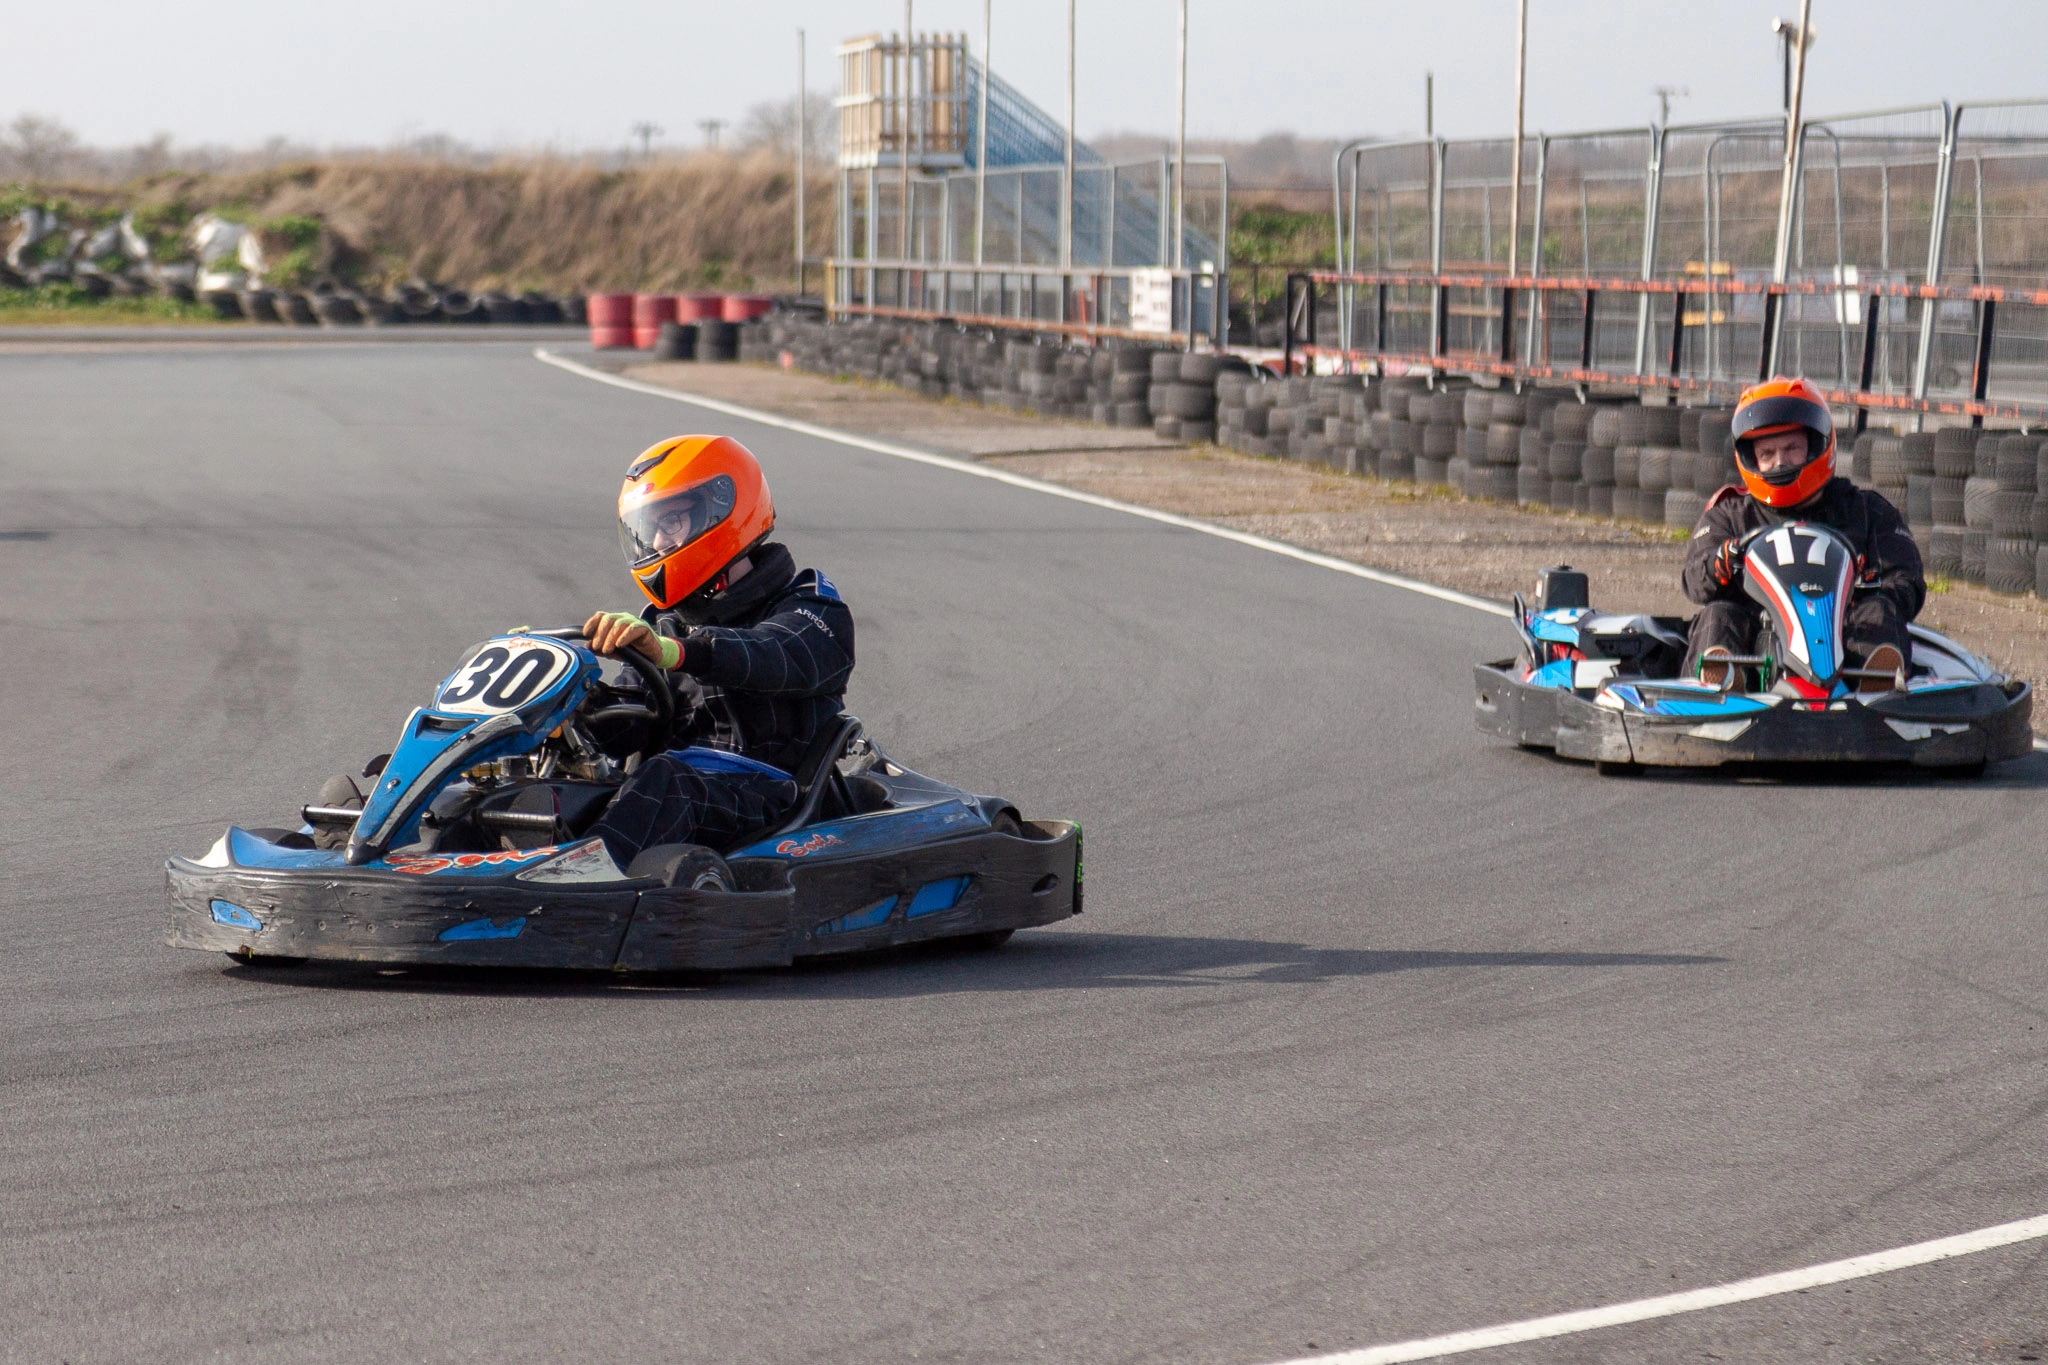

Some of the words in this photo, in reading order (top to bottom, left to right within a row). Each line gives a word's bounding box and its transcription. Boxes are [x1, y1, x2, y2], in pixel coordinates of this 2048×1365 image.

[1765, 527, 1831, 567] 17
[794, 608, 835, 638] ARROXY
[440, 646, 556, 709] 30
